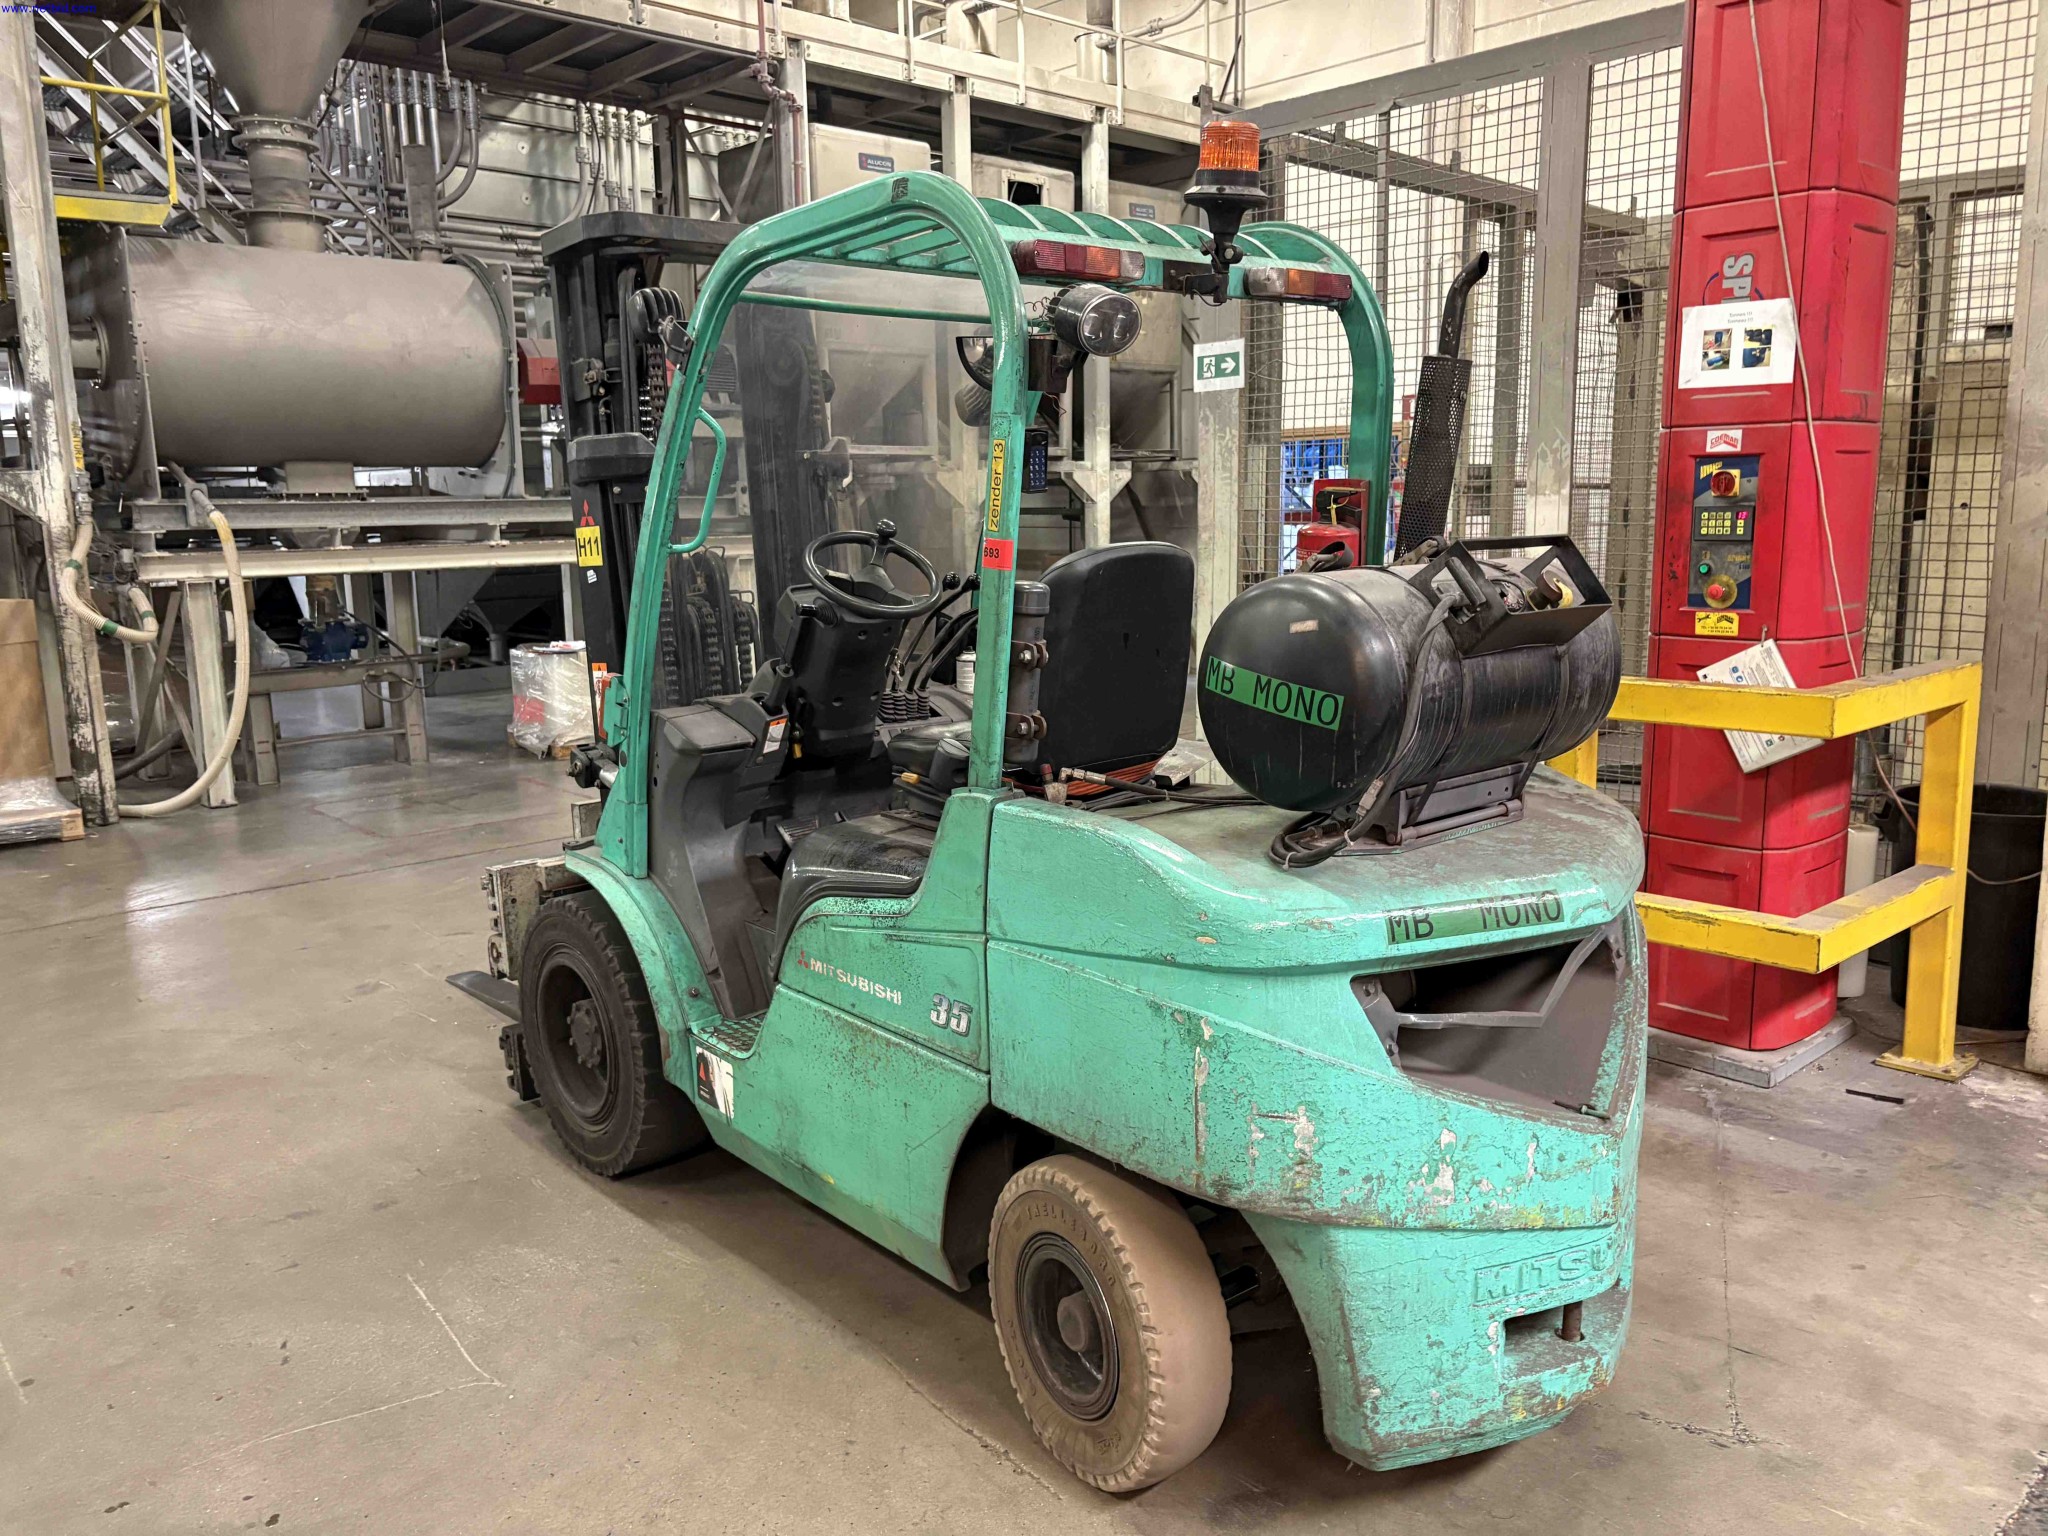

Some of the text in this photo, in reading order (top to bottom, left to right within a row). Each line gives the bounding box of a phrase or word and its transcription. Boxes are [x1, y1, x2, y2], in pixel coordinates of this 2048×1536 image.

[993, 442, 1004, 463] 13
[578, 536, 600, 557] H11
[983, 546, 1000, 559] 693
[1207, 657, 1339, 726] MB MONO
[1387, 889, 1562, 943] MB MONO
[810, 957, 902, 1006] MITSUBISHI
[929, 992, 973, 1038] 35
